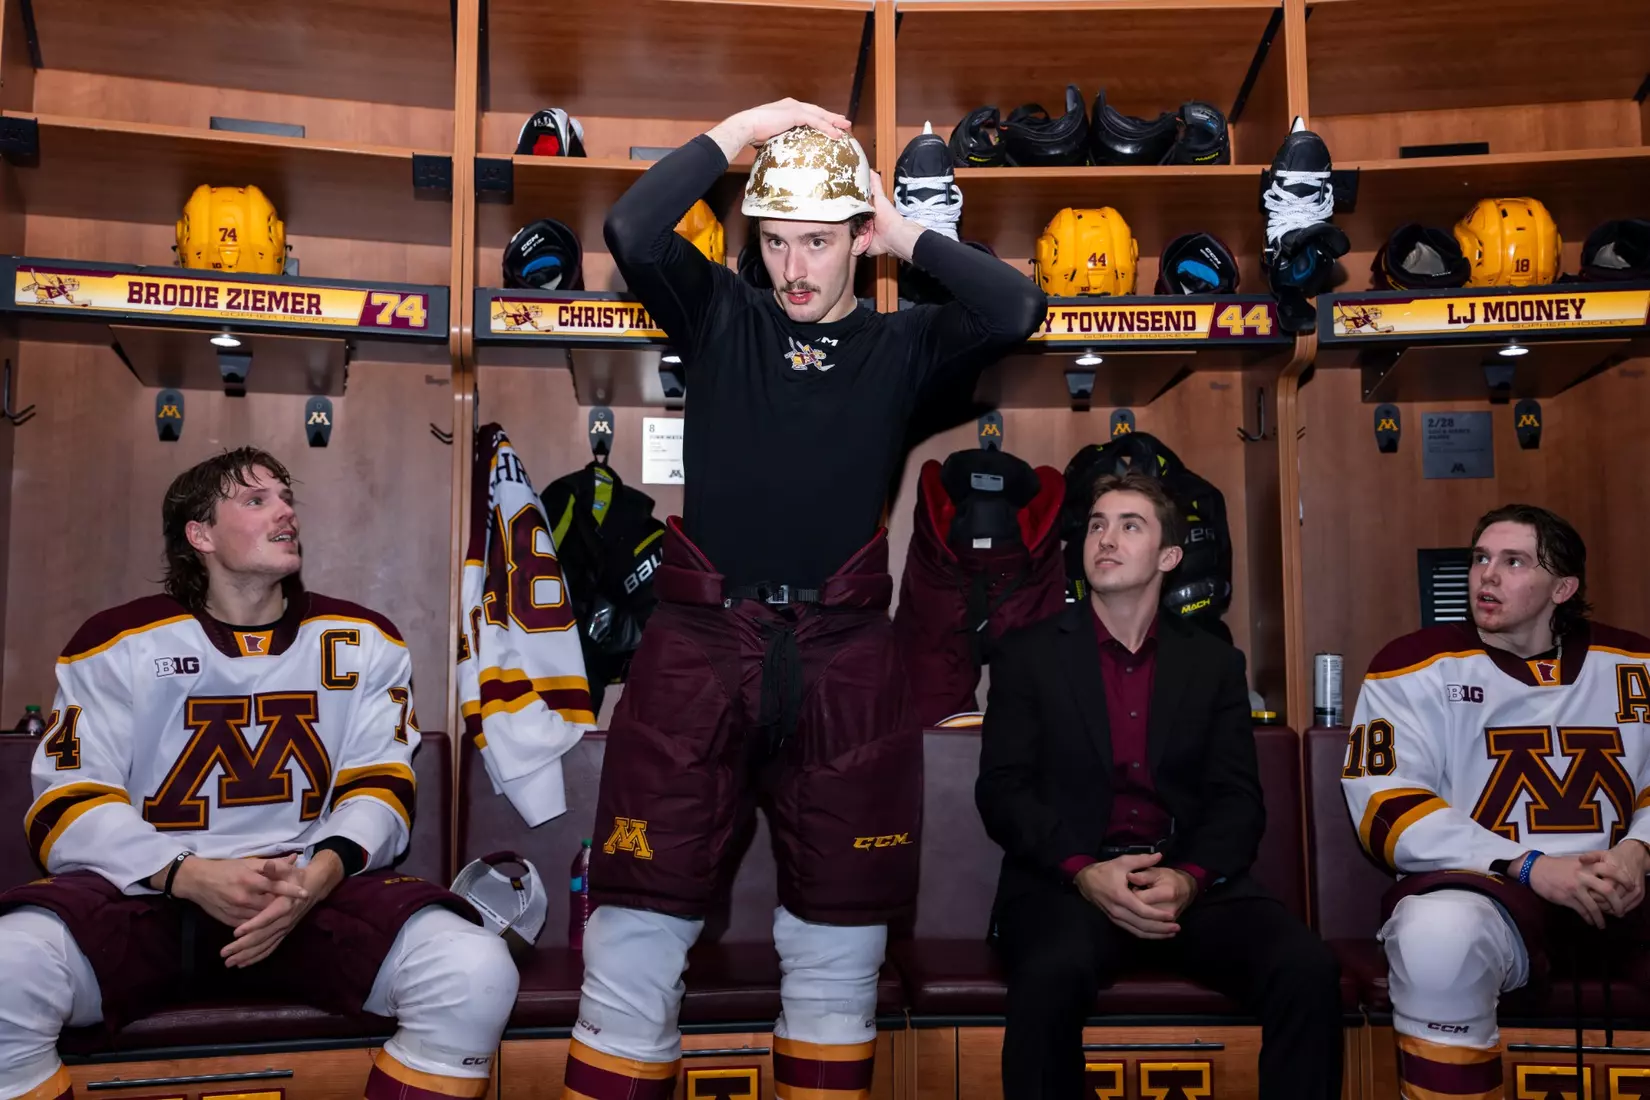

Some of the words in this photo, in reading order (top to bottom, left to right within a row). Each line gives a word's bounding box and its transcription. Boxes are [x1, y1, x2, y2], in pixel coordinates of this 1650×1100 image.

[218, 227, 238, 242] 74
[1088, 252, 1107, 267] 44
[1515, 258, 1530, 273] 18
[127, 281, 219, 309] BRODIE
[226, 288, 323, 315] ZIEMER
[371, 292, 427, 328] 74
[1447, 303, 1476, 324] LJ
[1483, 298, 1586, 323] MOONEY
[1061, 310, 1197, 333] TOWNSEND
[1217, 304, 1272, 336] 44
[1511, 321, 1572, 329] GOPHER
[1576, 319, 1627, 327] HOCKEY
[158, 405, 181, 418] M
[307, 412, 330, 425] M
[590, 421, 612, 434] M
[1377, 419, 1399, 431] M
[1518, 415, 1539, 427] M
[981, 424, 1000, 436] M
[1113, 423, 1132, 435] M
[1181, 598, 1211, 614] MACH
[320, 628, 361, 691] C
[1614, 663, 1650, 724] A
[1341, 717, 1397, 779] 18
[142, 690, 332, 832] M
[1470, 725, 1636, 850] M
[603, 816, 654, 860] M
[853, 832, 913, 851] CCM
[1427, 1022, 1470, 1034] CCM
